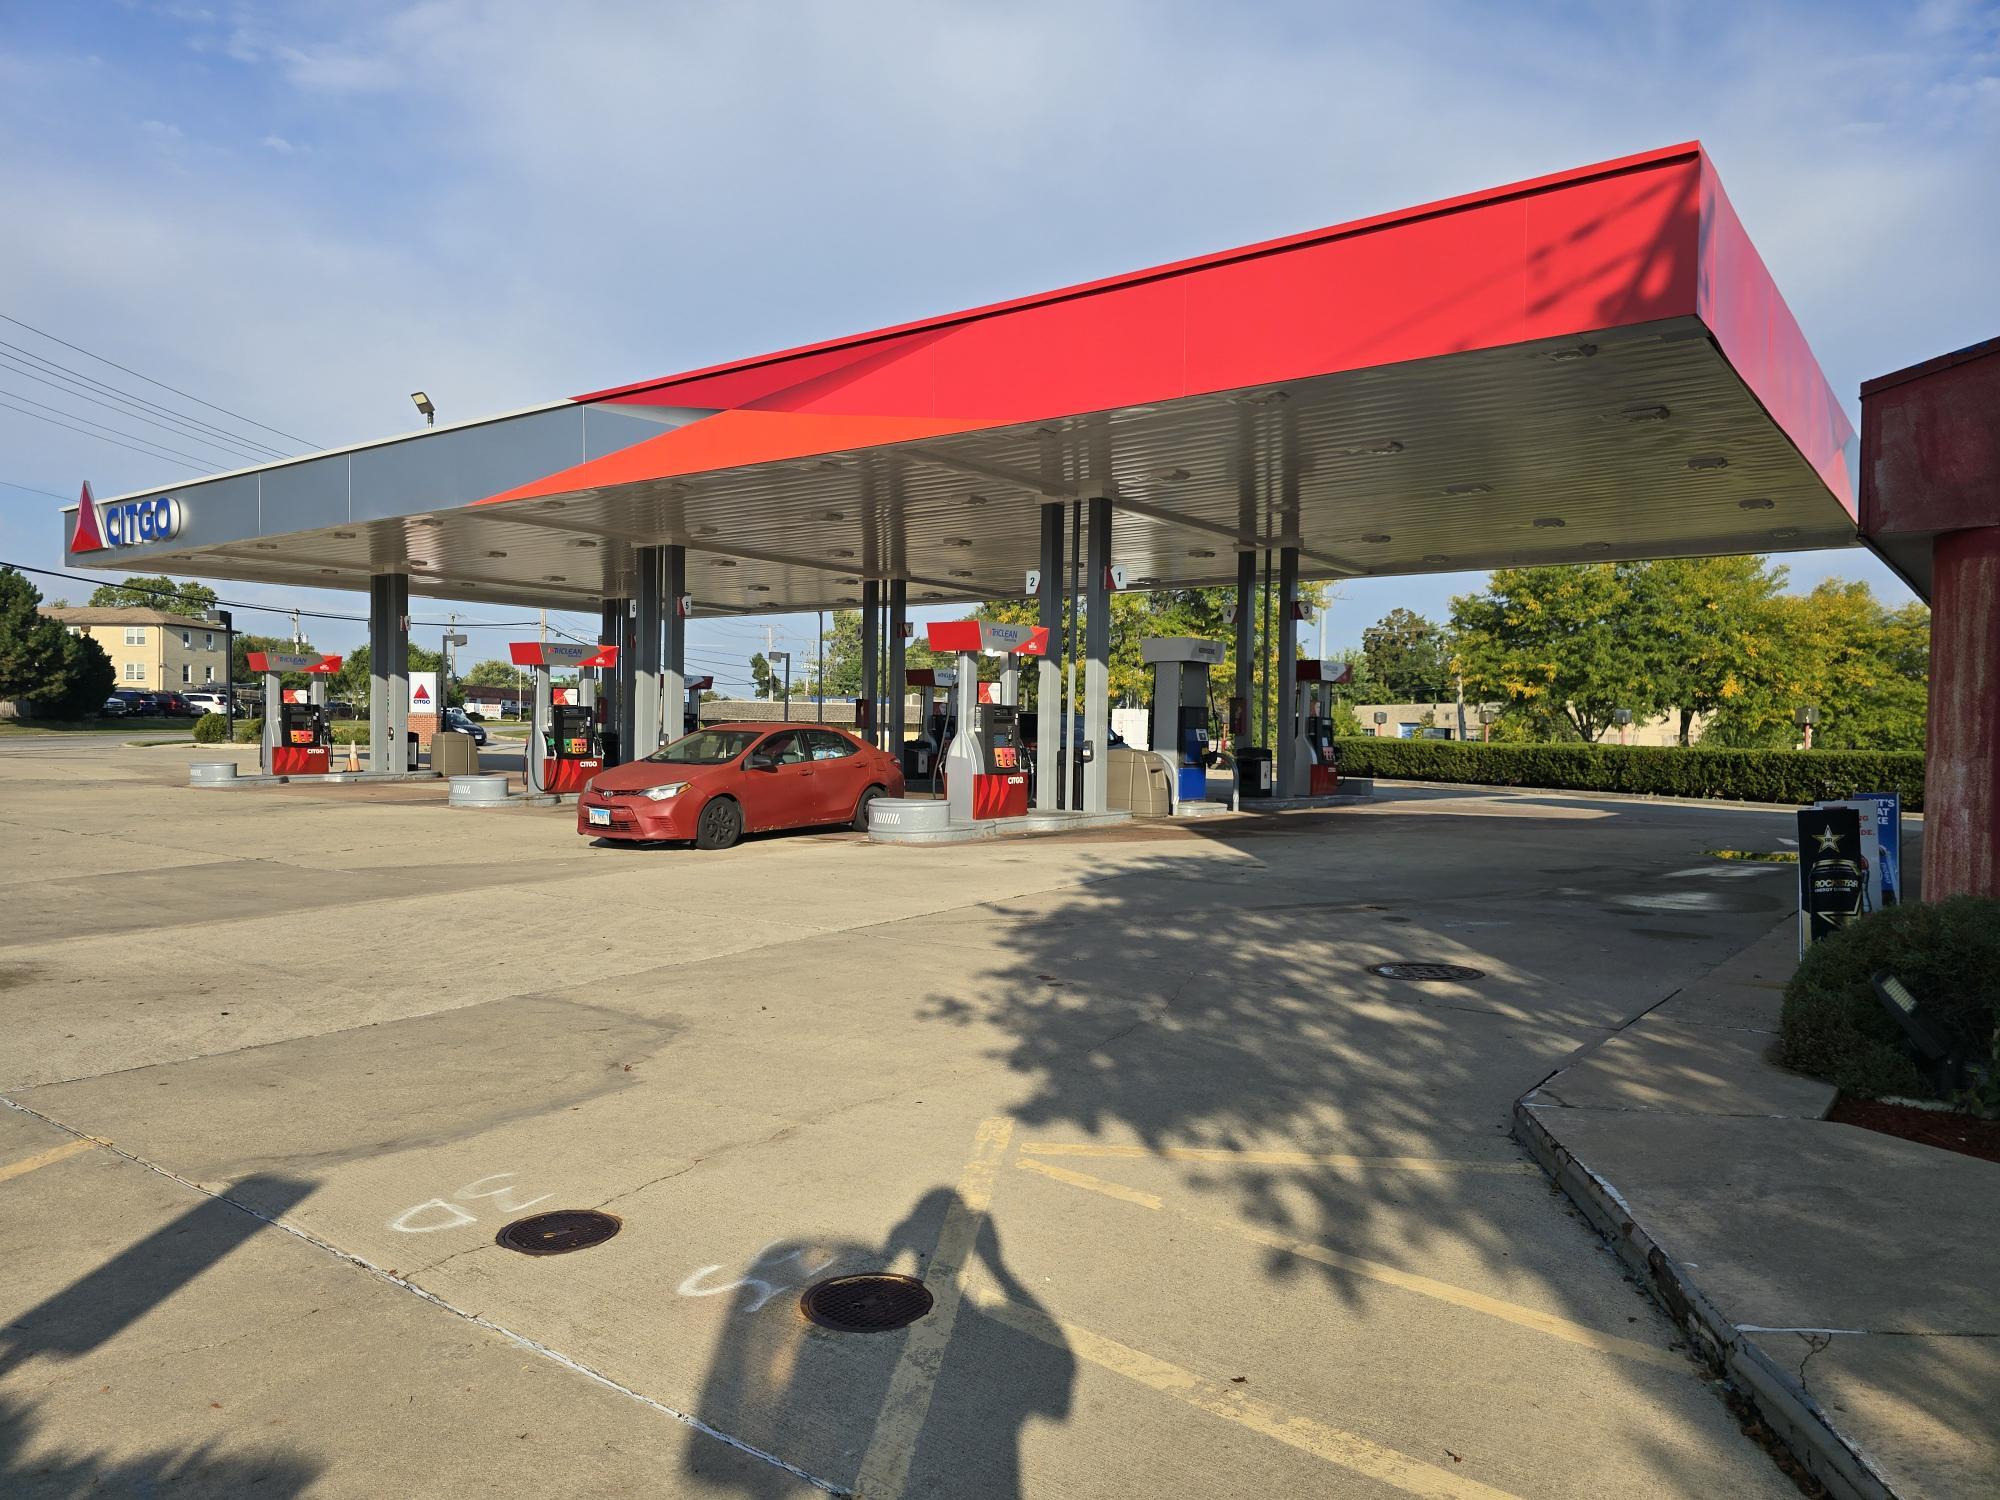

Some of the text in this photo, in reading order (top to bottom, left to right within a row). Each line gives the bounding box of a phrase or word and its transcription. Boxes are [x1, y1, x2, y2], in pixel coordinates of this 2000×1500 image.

[106, 497, 173, 546] CITGO
[1029, 576, 1035, 587] 2
[1117, 571, 1122, 582] 1
[1304, 606, 1309, 614] 3
[1007, 776, 1024, 784] CITGO
